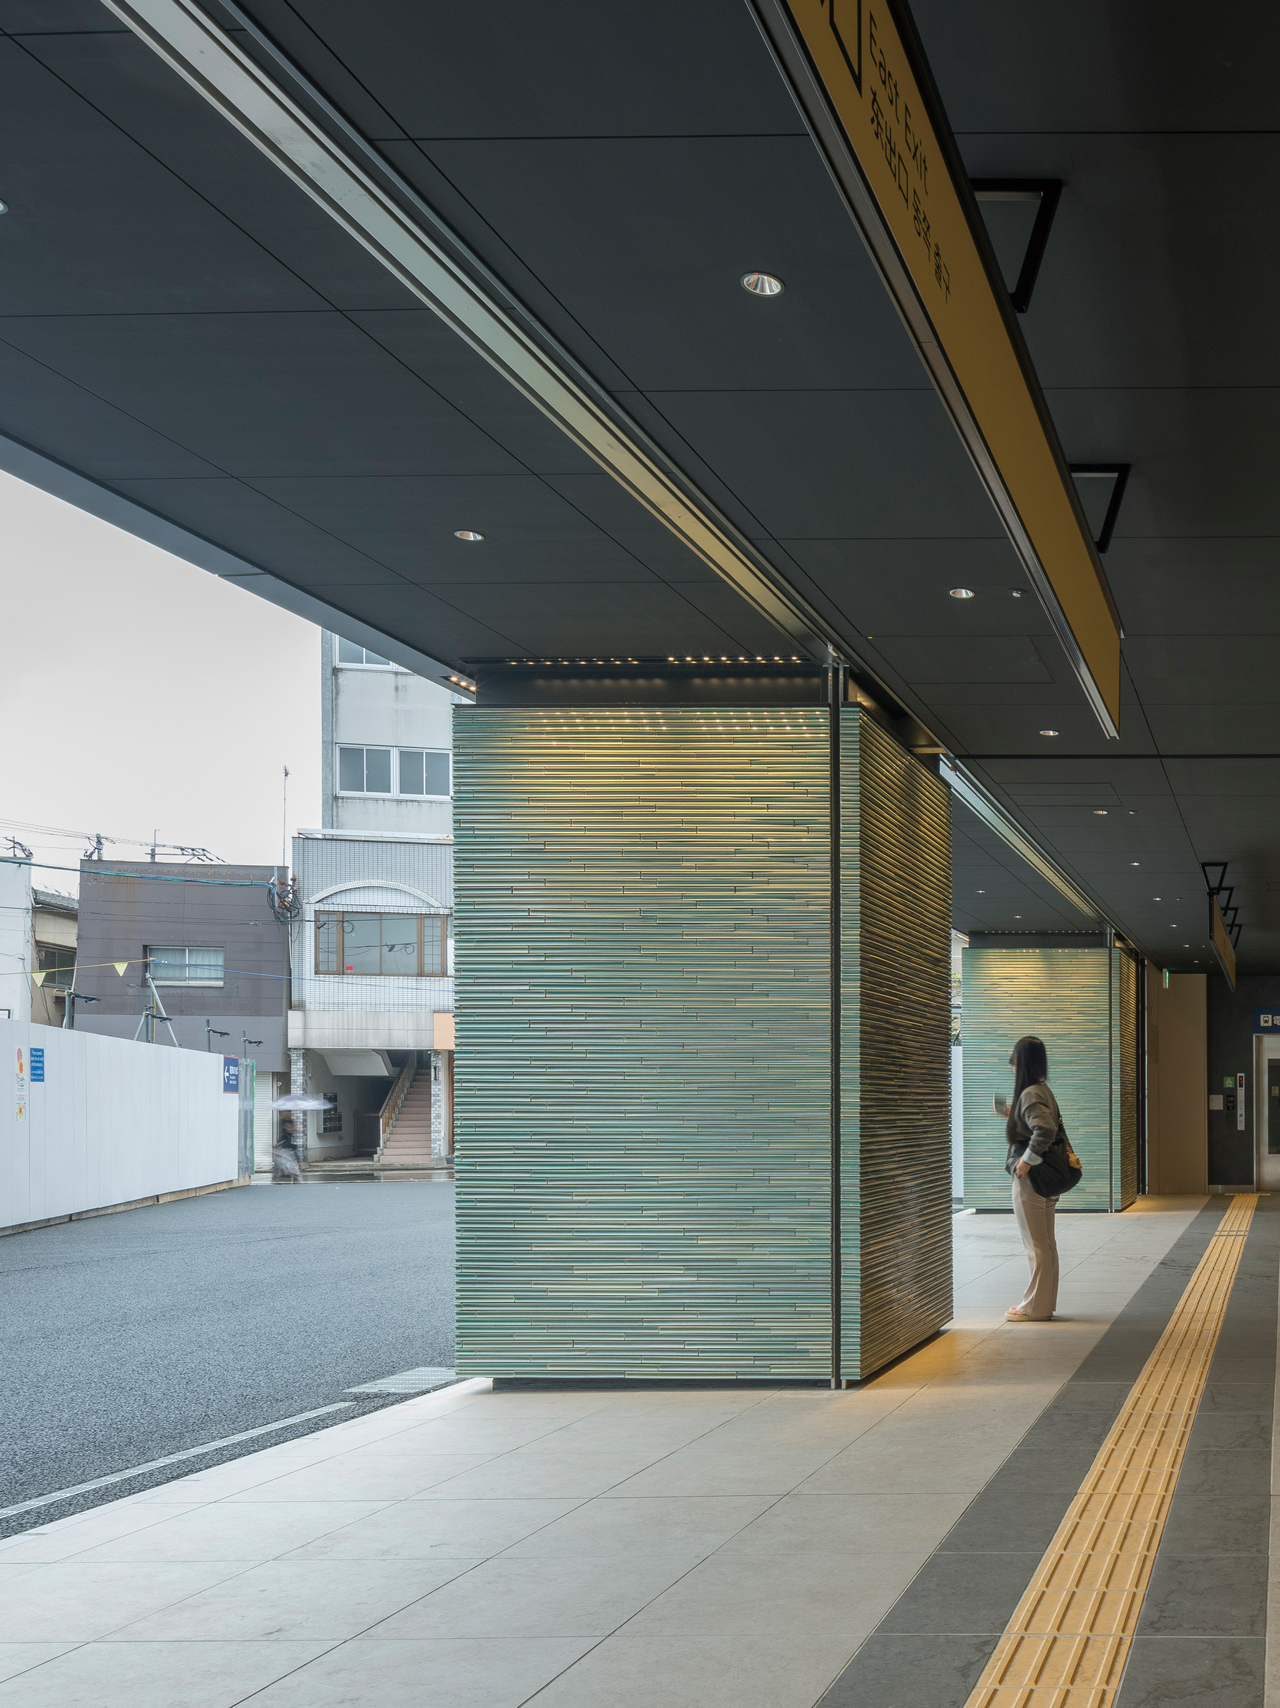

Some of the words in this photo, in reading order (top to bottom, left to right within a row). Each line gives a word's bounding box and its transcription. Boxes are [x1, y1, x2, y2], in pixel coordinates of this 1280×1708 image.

[869, 9, 900, 125] East
[904, 101, 928, 196] Exit
[869, 85, 909, 211] 东出口
